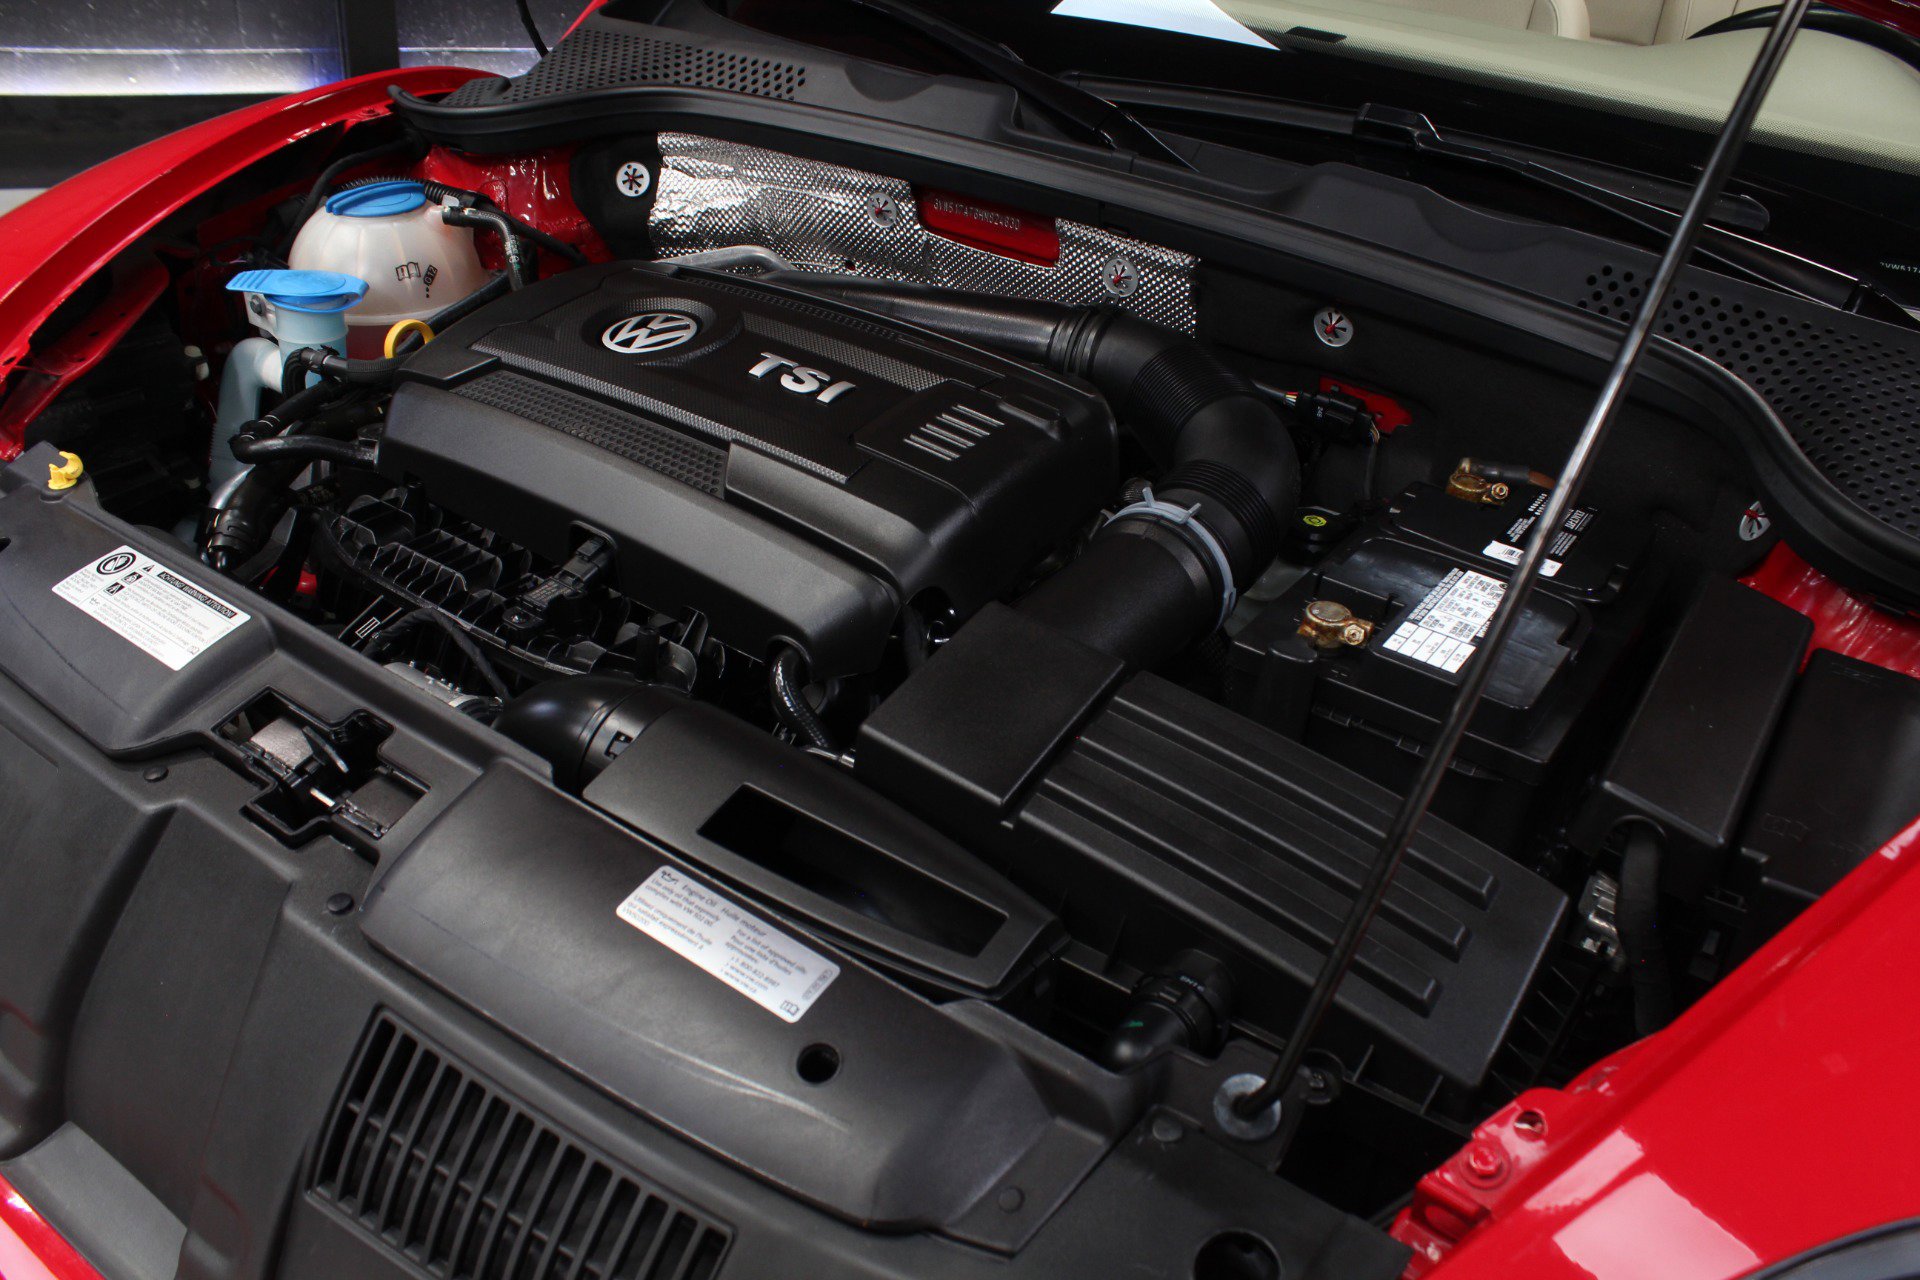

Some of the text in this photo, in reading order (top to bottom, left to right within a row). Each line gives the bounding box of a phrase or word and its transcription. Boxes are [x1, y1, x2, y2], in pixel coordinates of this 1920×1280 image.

[601, 313, 698, 354] VW
[748, 351, 857, 404] TSI
[682, 884, 767, 936] Engine Oil Huile moteur
